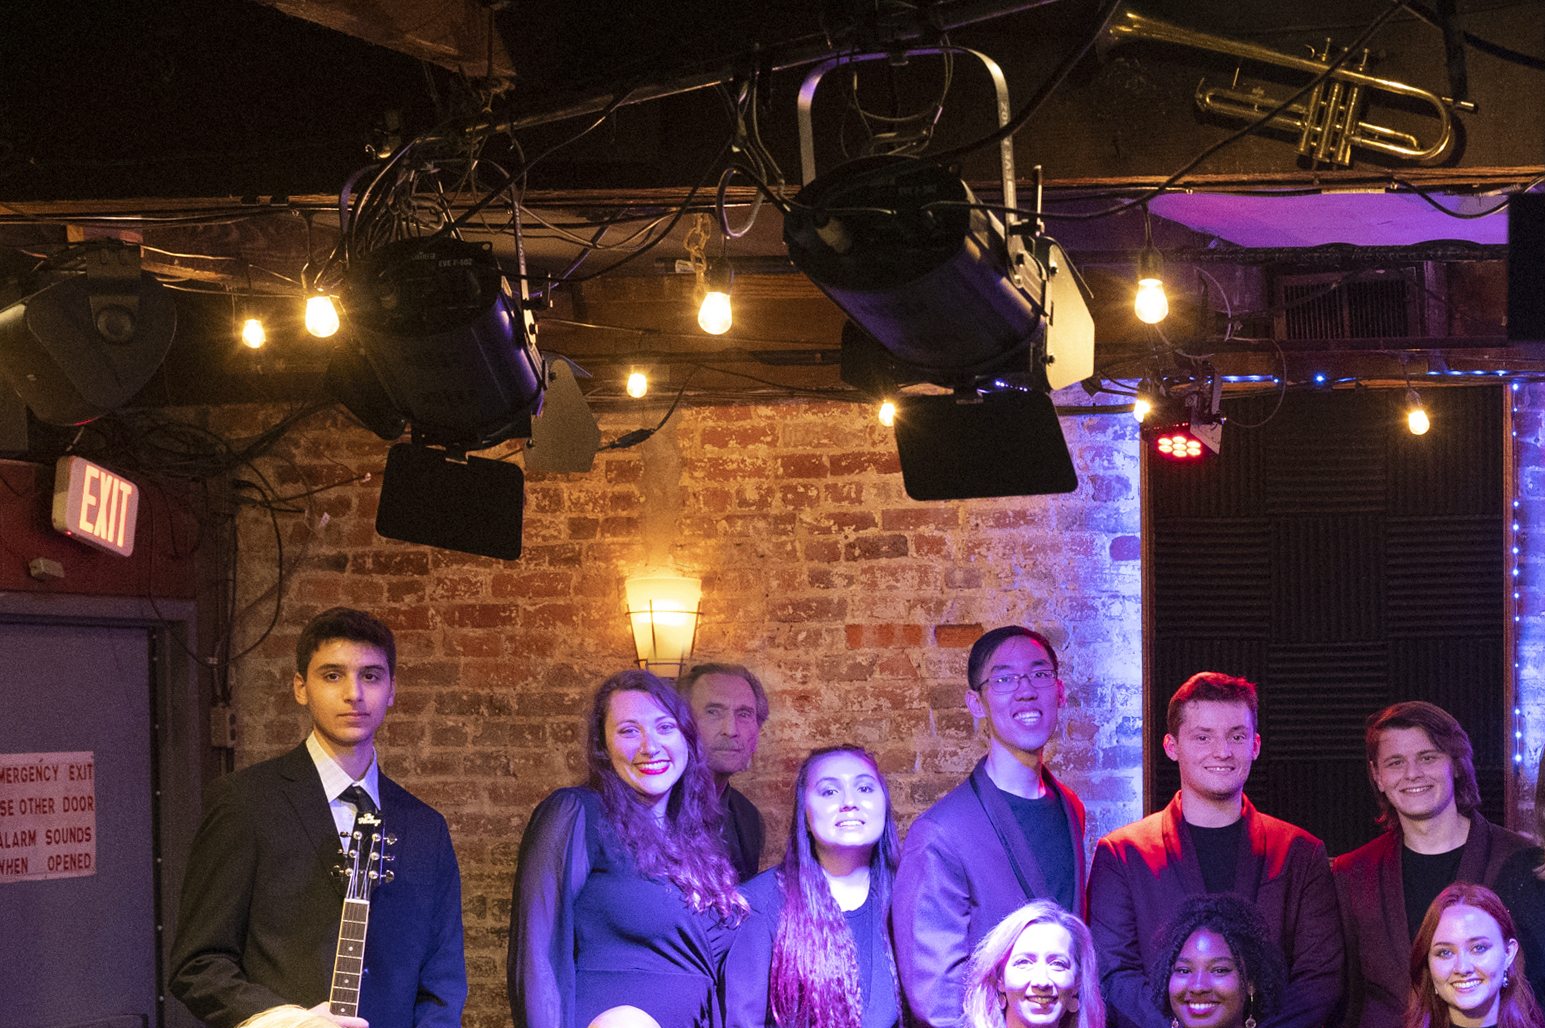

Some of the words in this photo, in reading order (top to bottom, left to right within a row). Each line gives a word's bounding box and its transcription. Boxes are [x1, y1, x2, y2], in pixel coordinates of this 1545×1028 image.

[78, 463, 134, 548] EXIT
[0, 766, 59, 783] MERGENCY
[70, 764, 93, 780] EXIT
[0, 800, 14, 816] SE
[20, 798, 54, 814] OTHER
[63, 797, 94, 812] DOOR
[46, 828, 91, 845] SOUNDS
[48, 854, 91, 871] OPENED
